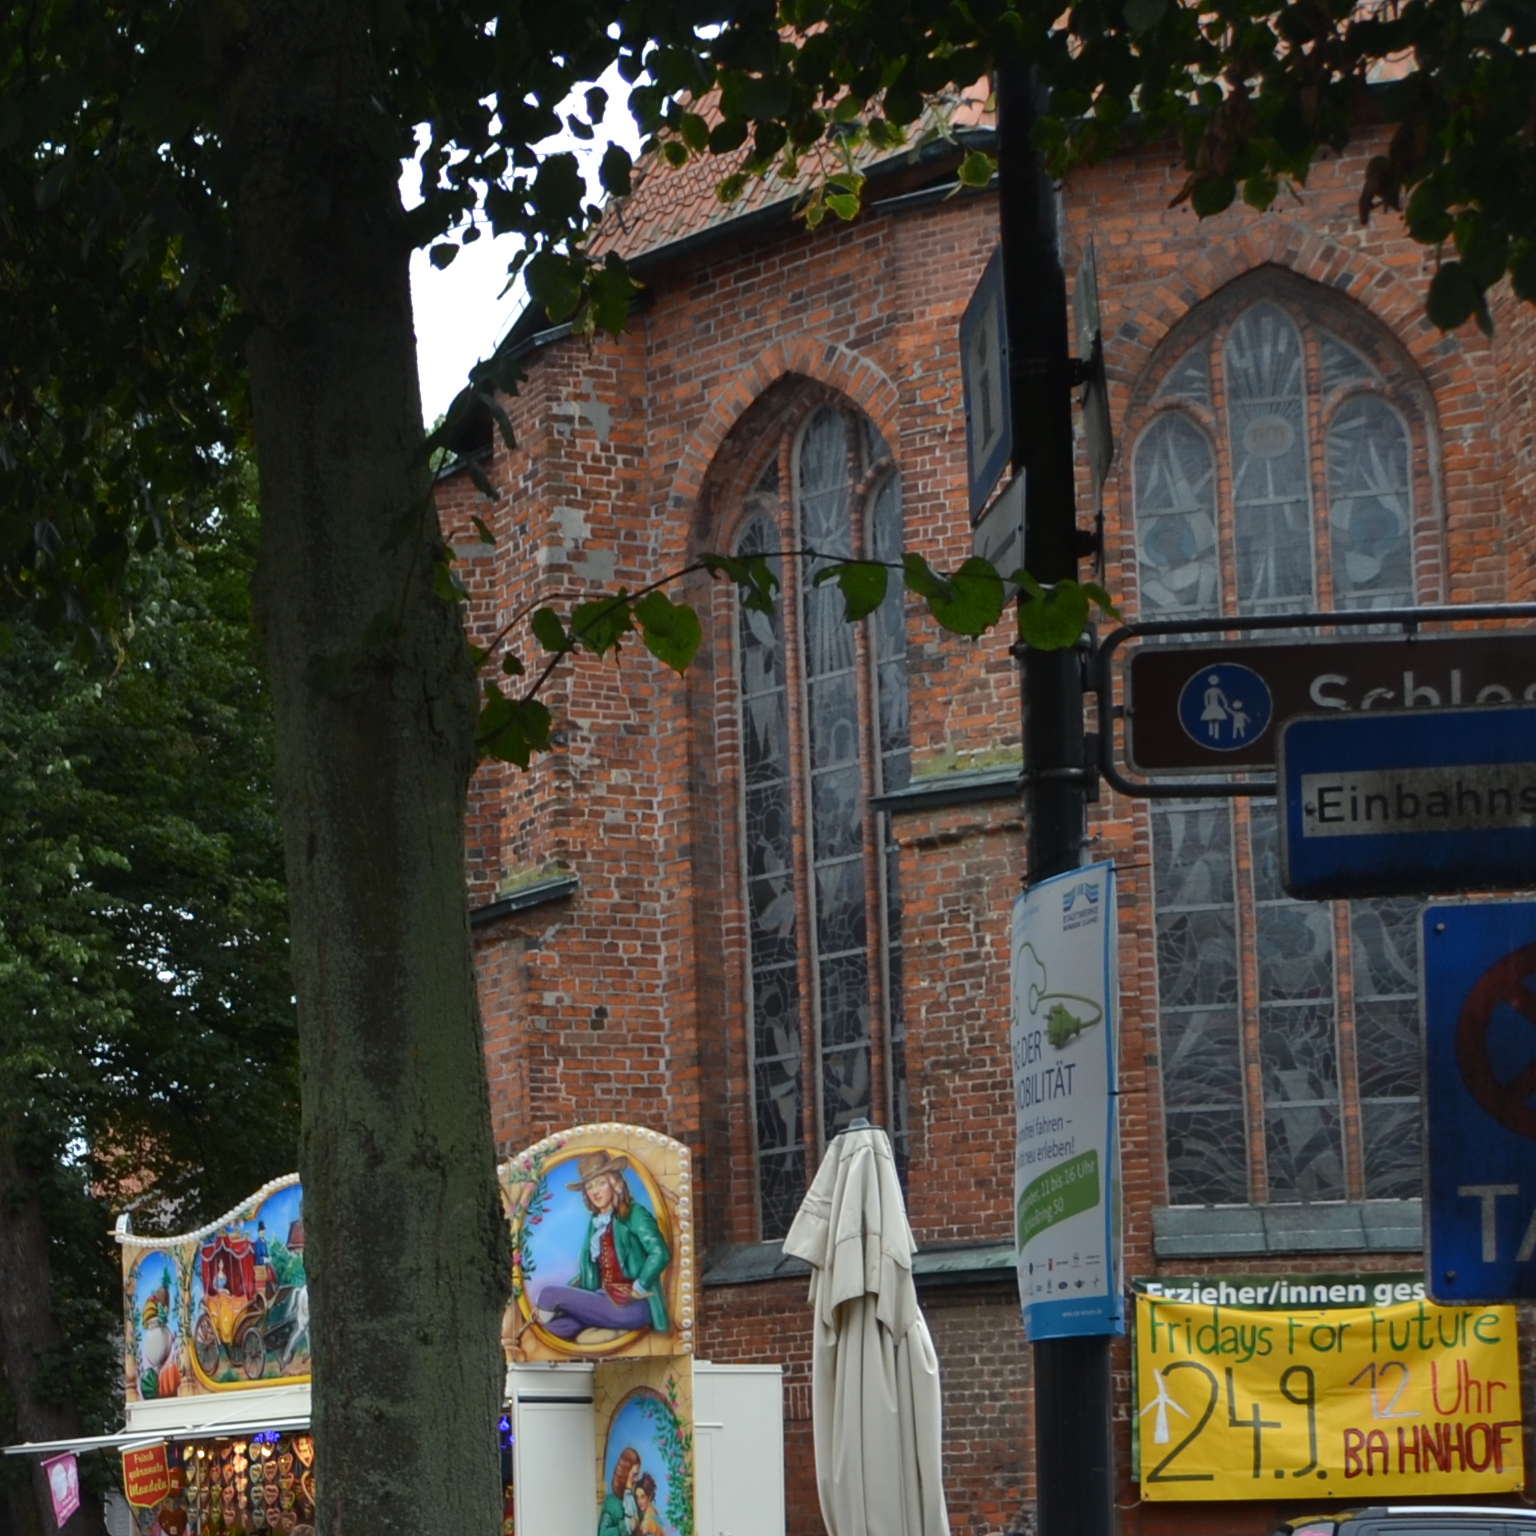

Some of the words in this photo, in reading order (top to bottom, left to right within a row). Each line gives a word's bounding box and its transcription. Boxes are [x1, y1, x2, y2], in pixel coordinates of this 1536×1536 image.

[1021, 1029, 1042, 1068] DER
[1018, 1060, 1076, 1110] OBILITÄT
[1036, 1116, 1064, 1136] fahren
[1036, 1135, 1075, 1161] erleben!
[1051, 1173, 1063, 1192] bis
[1064, 1165, 1076, 1185] 16
[1077, 1159, 1096, 1178] Uhr
[1053, 1196, 1065, 1216] 50
[1146, 1281, 1366, 1305] Erzieher/innen
[1148, 1301, 1274, 1363] Fridays
[1287, 1315, 1351, 1355] For
[1370, 1301, 1502, 1353] Future
[1349, 1361, 1420, 1421] 12
[1430, 1359, 1508, 1416] Uhr
[1343, 1420, 1522, 1479] BAHNHOF
[129, 1477, 167, 1498] Mandeln
